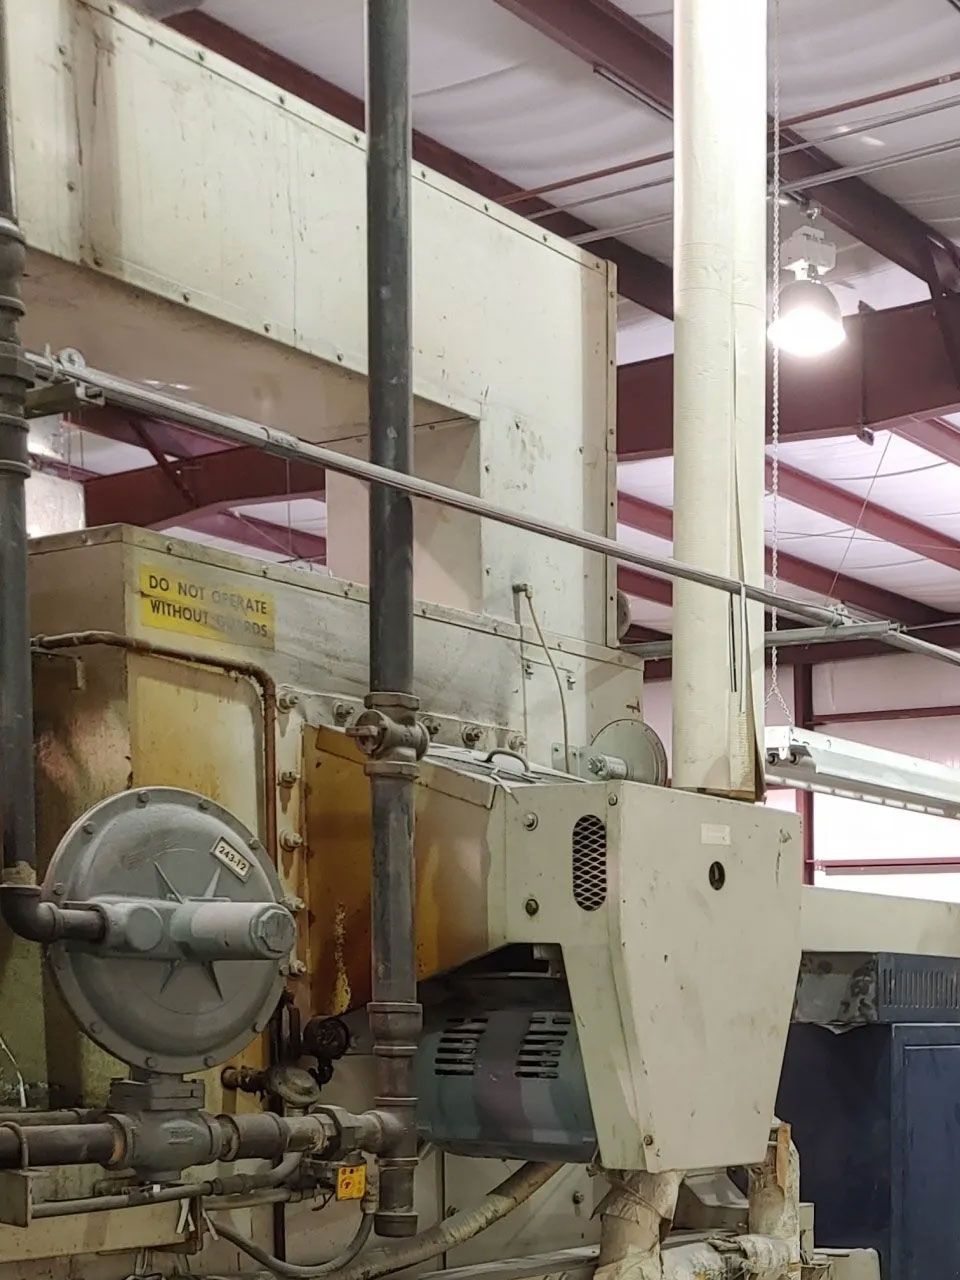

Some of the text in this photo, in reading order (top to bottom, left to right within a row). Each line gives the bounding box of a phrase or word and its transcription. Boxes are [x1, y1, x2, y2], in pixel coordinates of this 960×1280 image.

[149, 575, 267, 614] DO NOT OPERATE
[150, 599, 268, 637] WITHOUT GRDS
